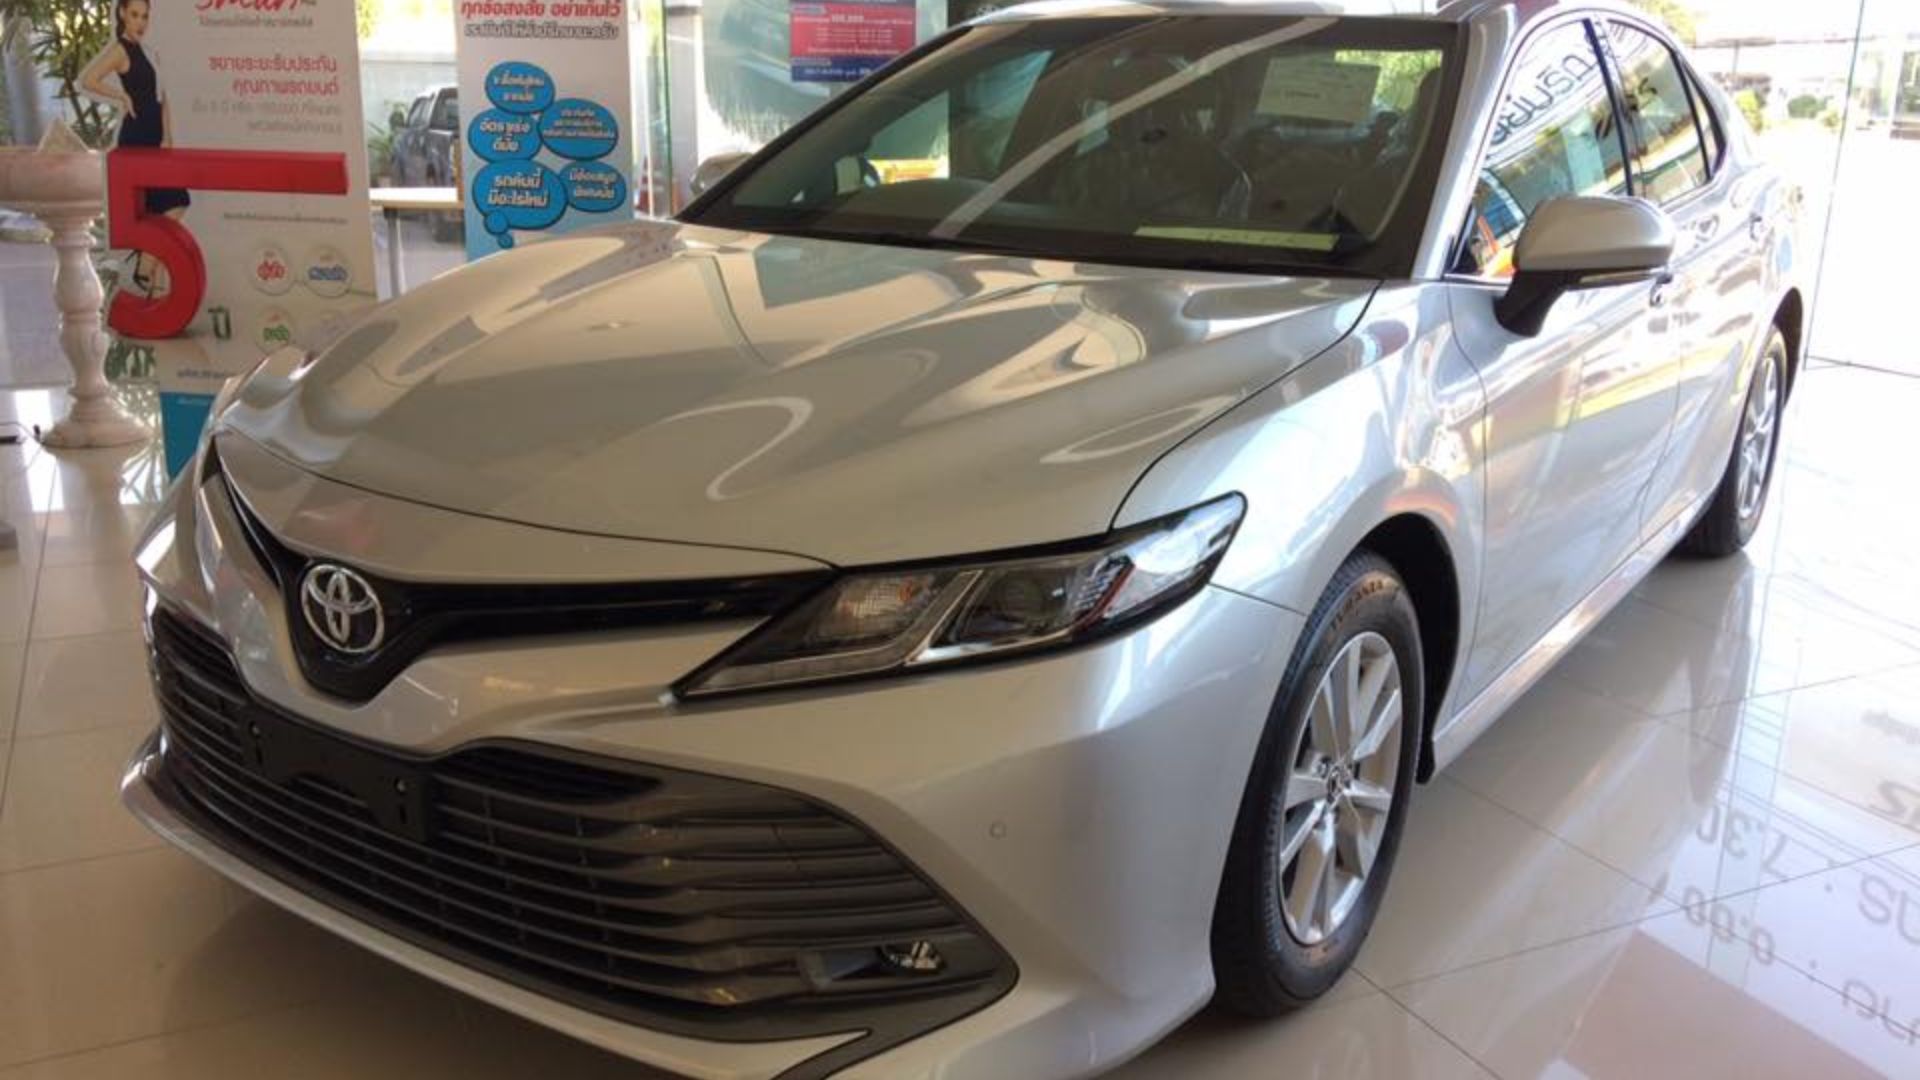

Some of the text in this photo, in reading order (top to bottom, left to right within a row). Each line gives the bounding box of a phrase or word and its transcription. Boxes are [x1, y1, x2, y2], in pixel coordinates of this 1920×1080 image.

[208, 54, 337, 71] ขยายระยะรับประกัน
[232, 78, 340, 97] คุณภาพรถยนต์
[106, 147, 348, 341] 5
[208, 304, 231, 340] ปี
